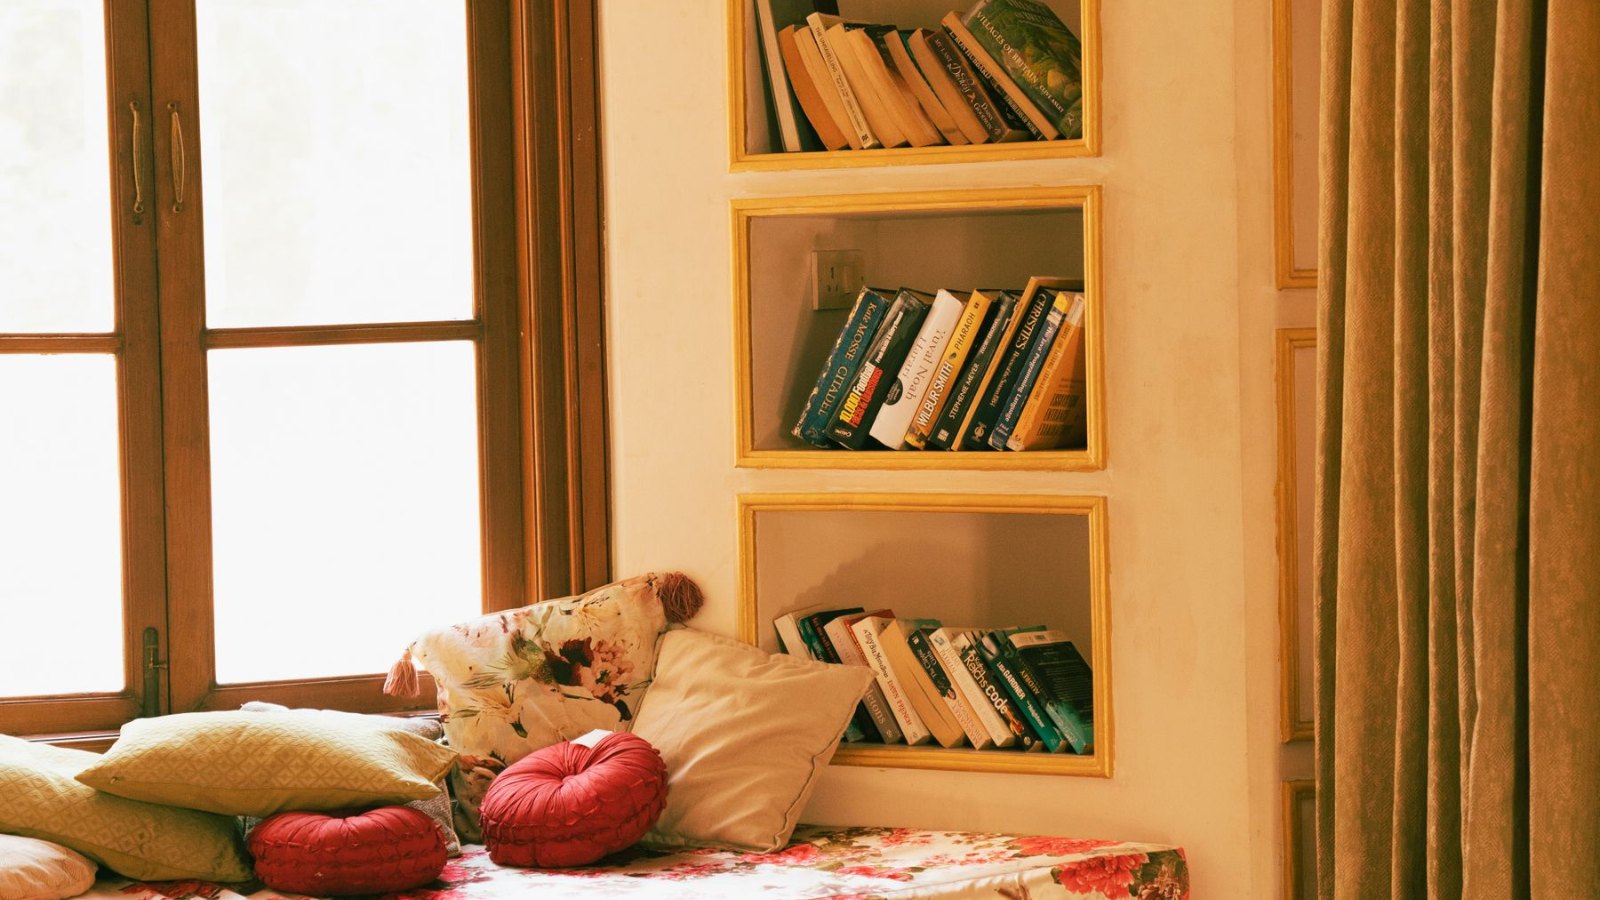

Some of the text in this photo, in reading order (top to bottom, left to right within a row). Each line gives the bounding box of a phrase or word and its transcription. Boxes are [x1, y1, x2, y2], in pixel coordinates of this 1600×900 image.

[977, 12, 1004, 45] VILLAGES
[1003, 44, 1014, 55] OF
[1012, 50, 1038, 85] BRITAIN
[845, 303, 876, 360] Kate MOSSE
[955, 312, 976, 350] PHARAOH
[903, 336, 927, 377] Harari
[906, 329, 946, 400] Yuval Noah
[1018, 352, 1040, 393] Programming
[818, 366, 847, 416] CITADEL
[839, 392, 859, 422] 10,000
[853, 361, 875, 392] Football
[917, 361, 953, 426] WILBUR SMITH
[949, 362, 979, 419] STEPHENIE MEYER
[1005, 394, 1020, 421] Language
[964, 653, 988, 687] Reichs
[1003, 669, 1025, 699] GARDNER
[888, 679, 912, 725] DAWN FRENCH
[985, 684, 1008, 714] code
